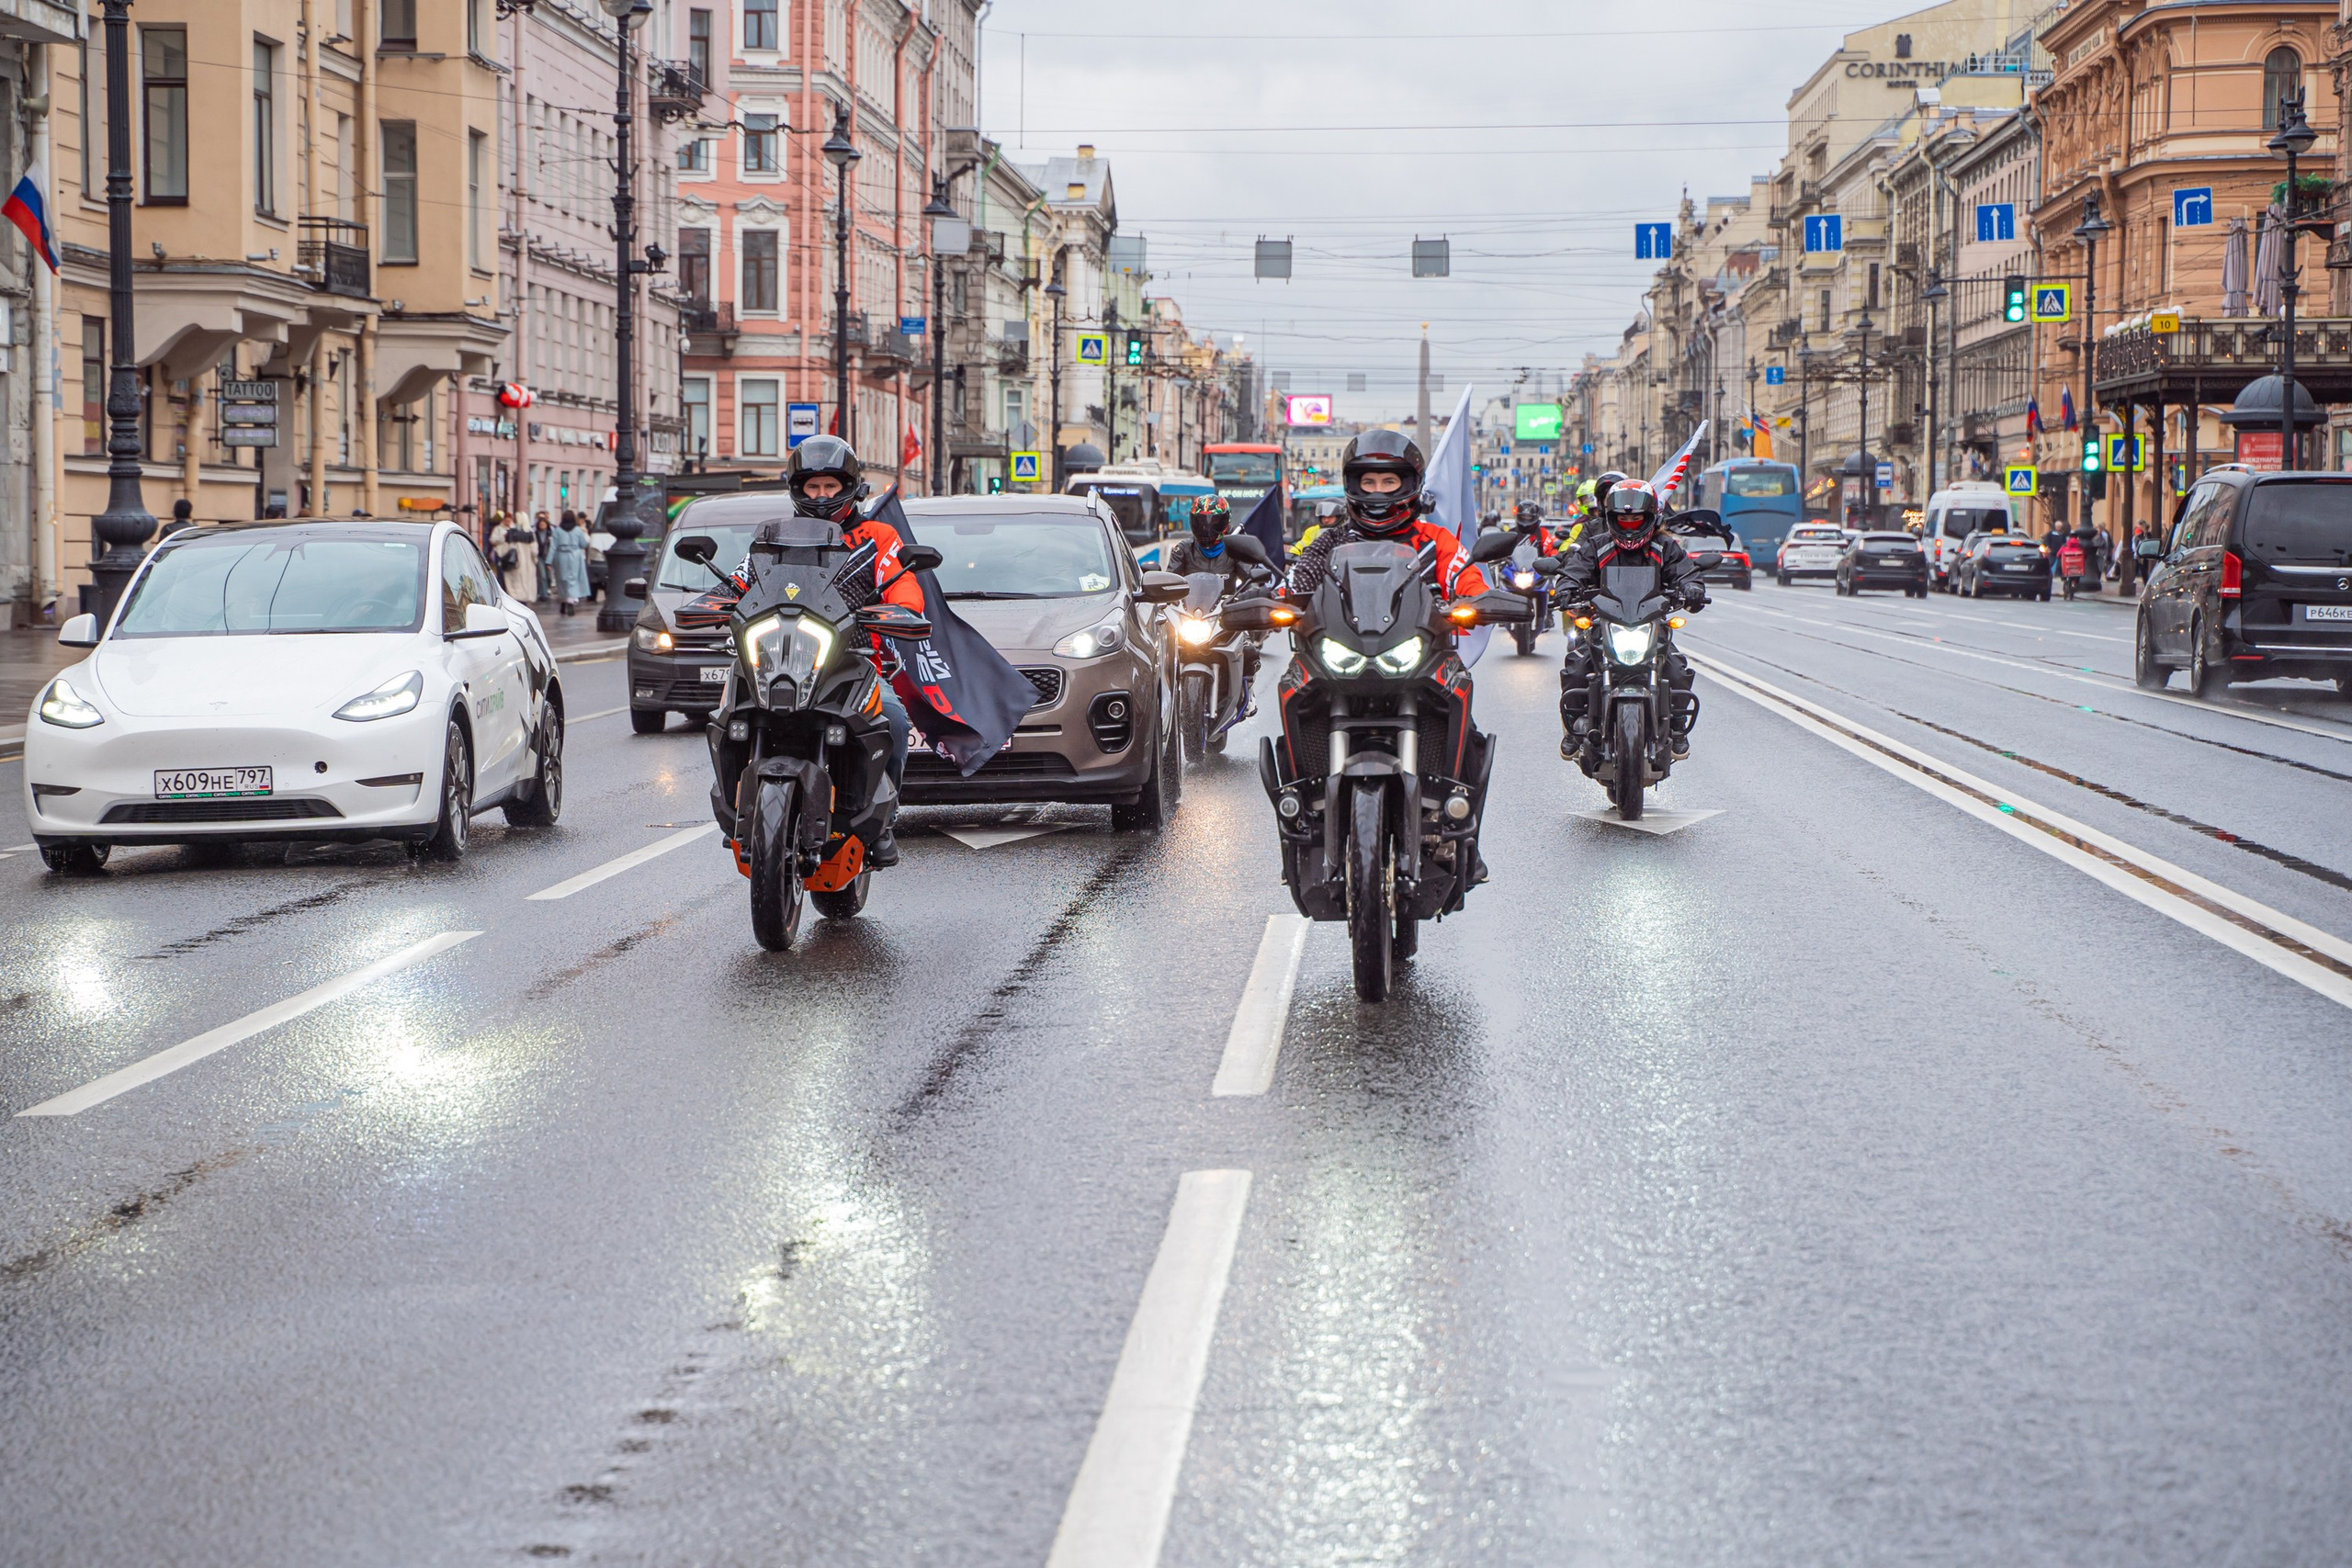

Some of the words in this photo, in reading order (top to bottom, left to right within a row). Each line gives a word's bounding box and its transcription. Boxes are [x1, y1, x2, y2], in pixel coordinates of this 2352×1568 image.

[2160, 321, 2171, 330] 10
[227, 383, 273, 397] TATTOO
[237, 770, 266, 784] 797
